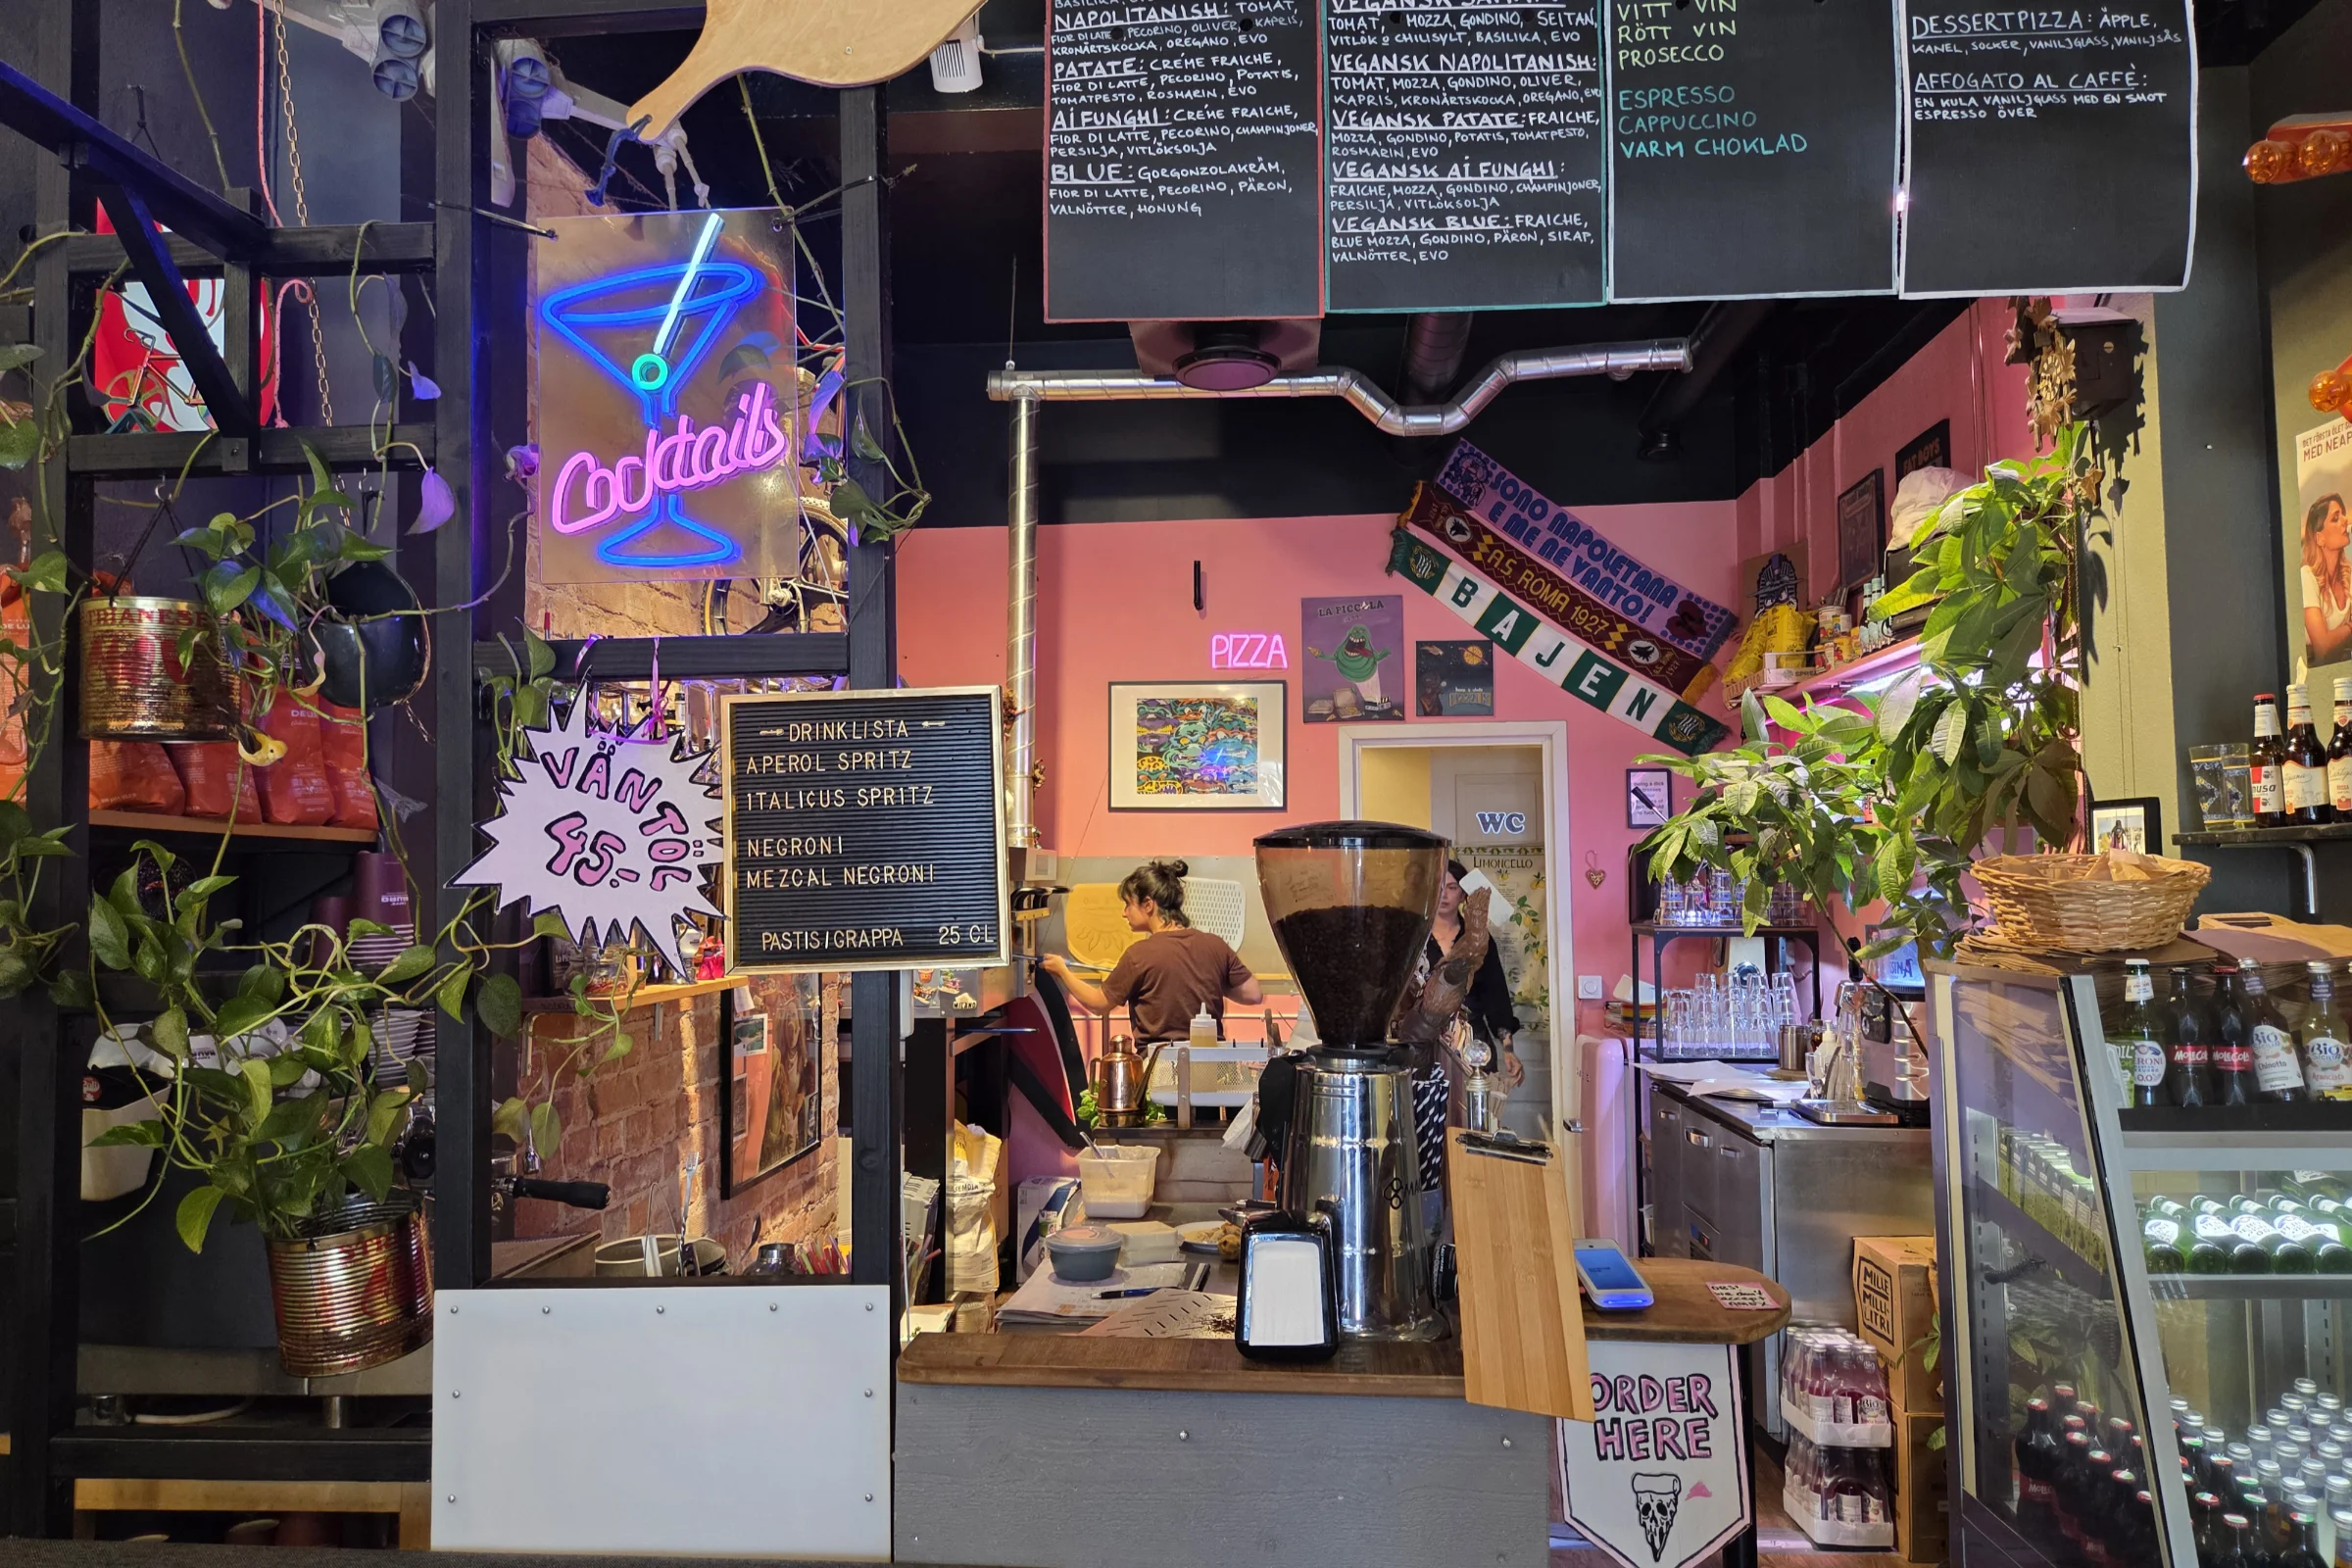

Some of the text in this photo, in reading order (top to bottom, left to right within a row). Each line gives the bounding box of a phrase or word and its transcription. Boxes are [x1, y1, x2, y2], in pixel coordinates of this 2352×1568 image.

[1054, 1, 1298, 31] NAPOLITANISH: TOMAT,
[1328, 8, 1597, 33] TOMAT, MOZZA, GONDINO, SEITAN,
[1617, 0, 1737, 22] VITT VIN
[1912, 5, 2157, 39] DESSERTPIZZA: ÄPPLE,
[1331, 28, 1581, 46] VITLÖK CHILISYLT, BASILIKA, EVO
[1618, 20, 1737, 44] RÖTT VIN
[1912, 29, 2181, 58] KANEL, SOCKER, VANILJGLASS, VANILJSÅS
[1053, 34, 1268, 56] KRONÄRTSKOCKA, OREGANO, EVO
[1619, 44, 1725, 70] PROSECCO
[1054, 53, 1282, 80] PATATE: FRAICHE,
[1331, 53, 1597, 74] VEGANSK NAPOLITANISH:
[1052, 73, 1234, 93] FIOR DI LATTE, PECORINO,
[1331, 74, 1582, 92] TOMAT, MOZZA, GONDINO, OLIVER,
[1915, 63, 2148, 92] AFFOGATO AL CAFFÈ:
[1052, 85, 1257, 106] TOMATPESTO, ROSMARIN, EVO
[1334, 90, 1584, 109] KAPRIS, OREGANO,
[1619, 85, 1736, 111] ESPRESSO
[1915, 92, 2167, 109] EN KULA VANILJGLASS MED EN SHOT
[1080, 105, 1298, 128] FUNGHI: FRAICHE,
[1333, 110, 1599, 132] VEGANSK PATATE: FRAICHE,
[1618, 111, 1757, 135] CAPPUCCINO
[1914, 105, 2037, 121] ESPRESSO ÖVER
[1051, 122, 1318, 145] FIOR DI LATTE, PECORINO, CHAMPINJONER,
[1332, 127, 1590, 149] MOZZA, GONDINO, POTATIS, TOMATPESTO,
[1051, 141, 1217, 160] PERSILJA, VITLÖKSOLJA
[1332, 146, 1439, 160] ROSMARIN, EVO
[1620, 133, 1807, 159] VARM CHOKLAD
[1051, 157, 1285, 183] BLUE: GORGONZOLAKRÄM,
[1333, 161, 1565, 183] VEGANSK FUNGHI:
[1050, 177, 1293, 201] FIOR DI LATTE, PECORINO, PÄRON,
[1330, 179, 1602, 198] FRAICHE, MOZZA, GONDINO, CHAMPINJONER,
[1051, 201, 1201, 220] VALNÖTTER, HONUNG
[1403, 195, 1500, 211] VITLÖKSOLJA
[1333, 213, 1588, 236] VEGANSK BLUE: FRAICHE,
[1331, 228, 1594, 248] BLUE MOZZA, GONDINO, PÄRON, SIRAP,
[1333, 249, 1449, 265] VALNÖTTER, EVO
[552, 381, 788, 535] Cocktails
[2303, 444, 2323, 462] MED
[1489, 469, 1679, 610] SONO NAPOLETANA
[1488, 500, 1504, 524] E
[1502, 513, 1542, 551] ME
[1541, 536, 1572, 568] NE
[1571, 554, 1654, 625] VANTO!
[1318, 608, 1333, 617] LA
[1517, 567, 1571, 613] ROMA
[1569, 599, 1611, 636] 1927
[1210, 633, 1288, 669] PIZZA
[1450, 575, 1657, 722] BAJEN
[789, 719, 909, 743] DRINKLISTA
[746, 750, 912, 775] APEROL SPRITZ
[747, 786, 935, 811] ITALICUS SPRITZ
[1476, 811, 1525, 835] WC
[747, 835, 843, 858] NEGRONI
[1473, 857, 1533, 868] LIMONCELLO
[747, 863, 935, 890] MEZCAL NEGRONI
[761, 923, 995, 951] PASTIS/GRAPPA 25 CL
[2258, 1060, 2287, 1071] Chinotto
[1863, 1266, 1889, 1295] MILLE
[1862, 1290, 1889, 1314] MILLI-
[1862, 1307, 1889, 1335] LITRI
[1590, 1373, 1719, 1420] ORDER
[1594, 1417, 1713, 1461] HERE
